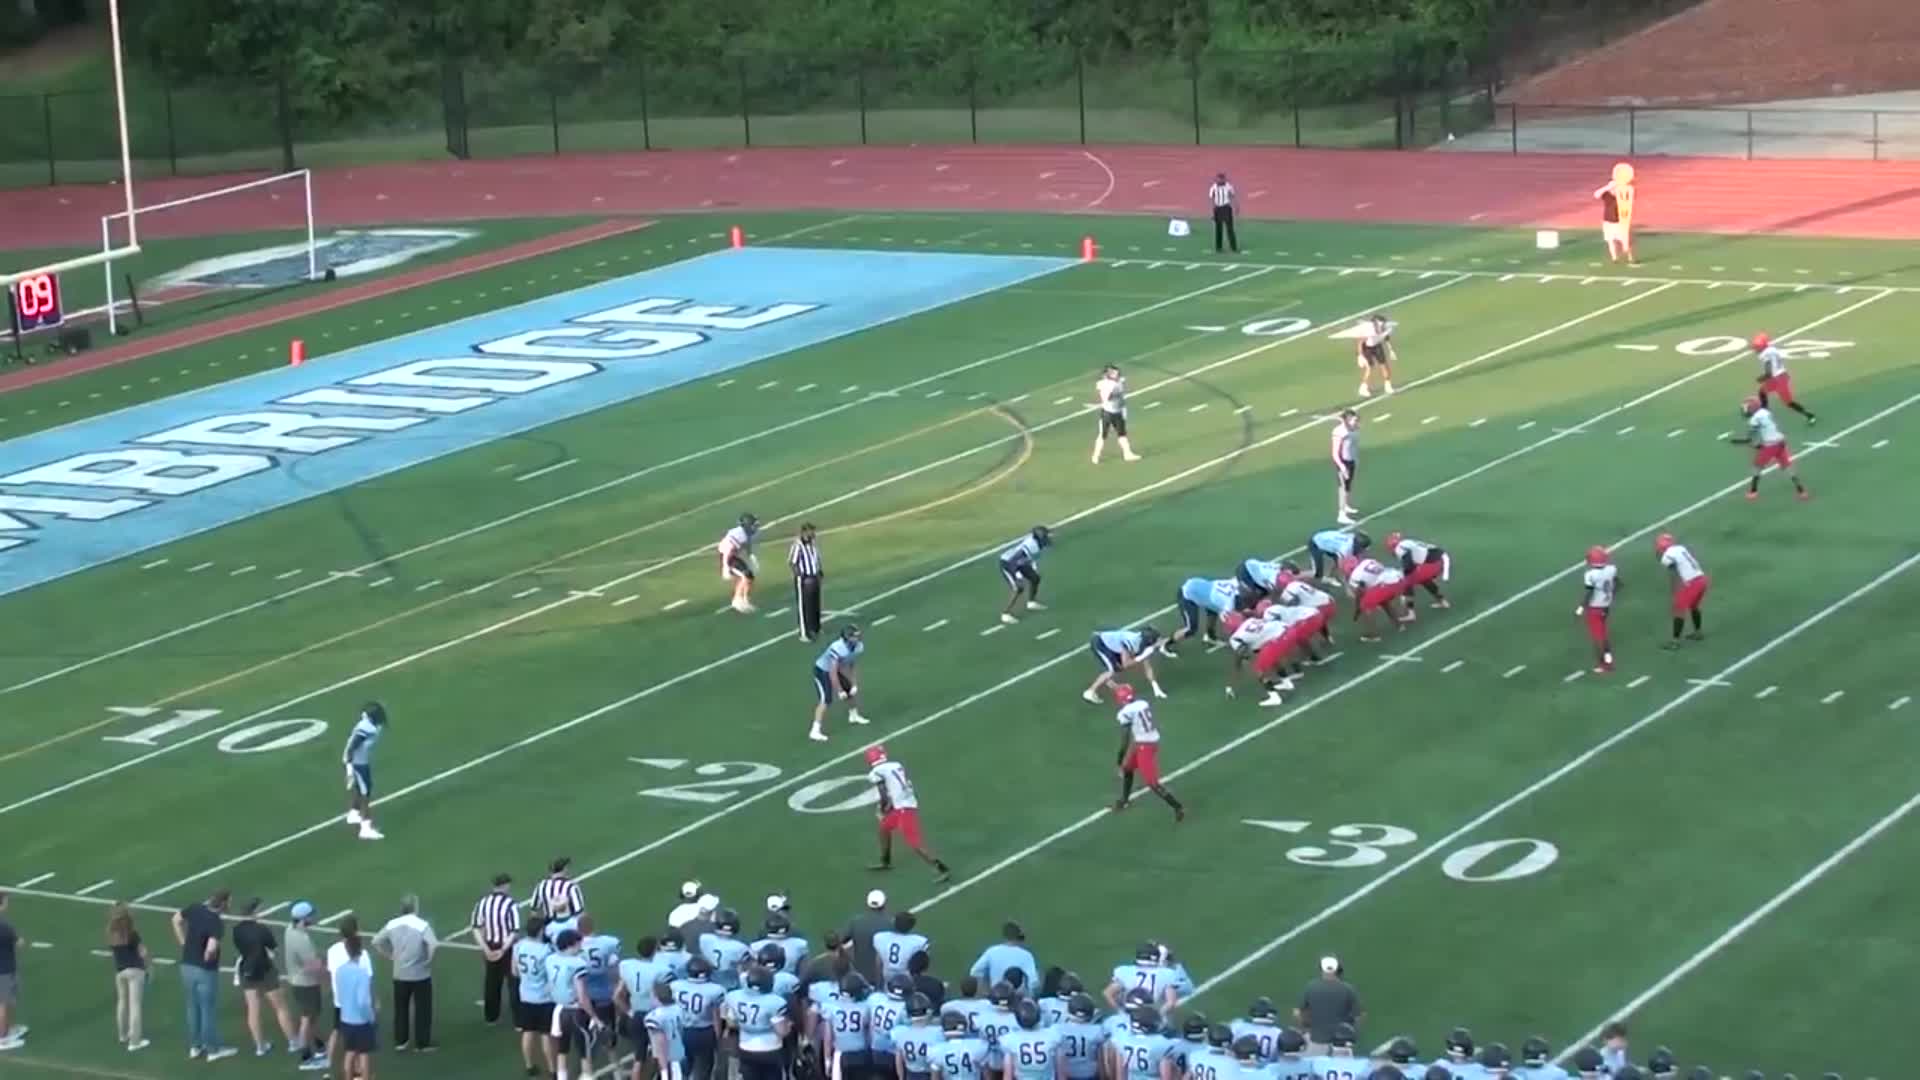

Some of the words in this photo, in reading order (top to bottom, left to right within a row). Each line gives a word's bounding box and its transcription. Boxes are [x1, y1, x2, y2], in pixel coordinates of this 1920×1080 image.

[20, 274, 54, 316] 09
[101, 708, 329, 753] 10
[637, 761, 882, 813] 20
[1285, 823, 1560, 882] 30
[888, 943, 901, 965] 8
[678, 990, 704, 1015] 50
[737, 1002, 761, 1026] 57
[835, 1009, 861, 1033] 39
[903, 1040, 928, 1061] 84
[1019, 1041, 1048, 1066] 65
[1064, 1034, 1087, 1058] 31
[1123, 1045, 1149, 1072] 76
[944, 1052, 973, 1075] 54
